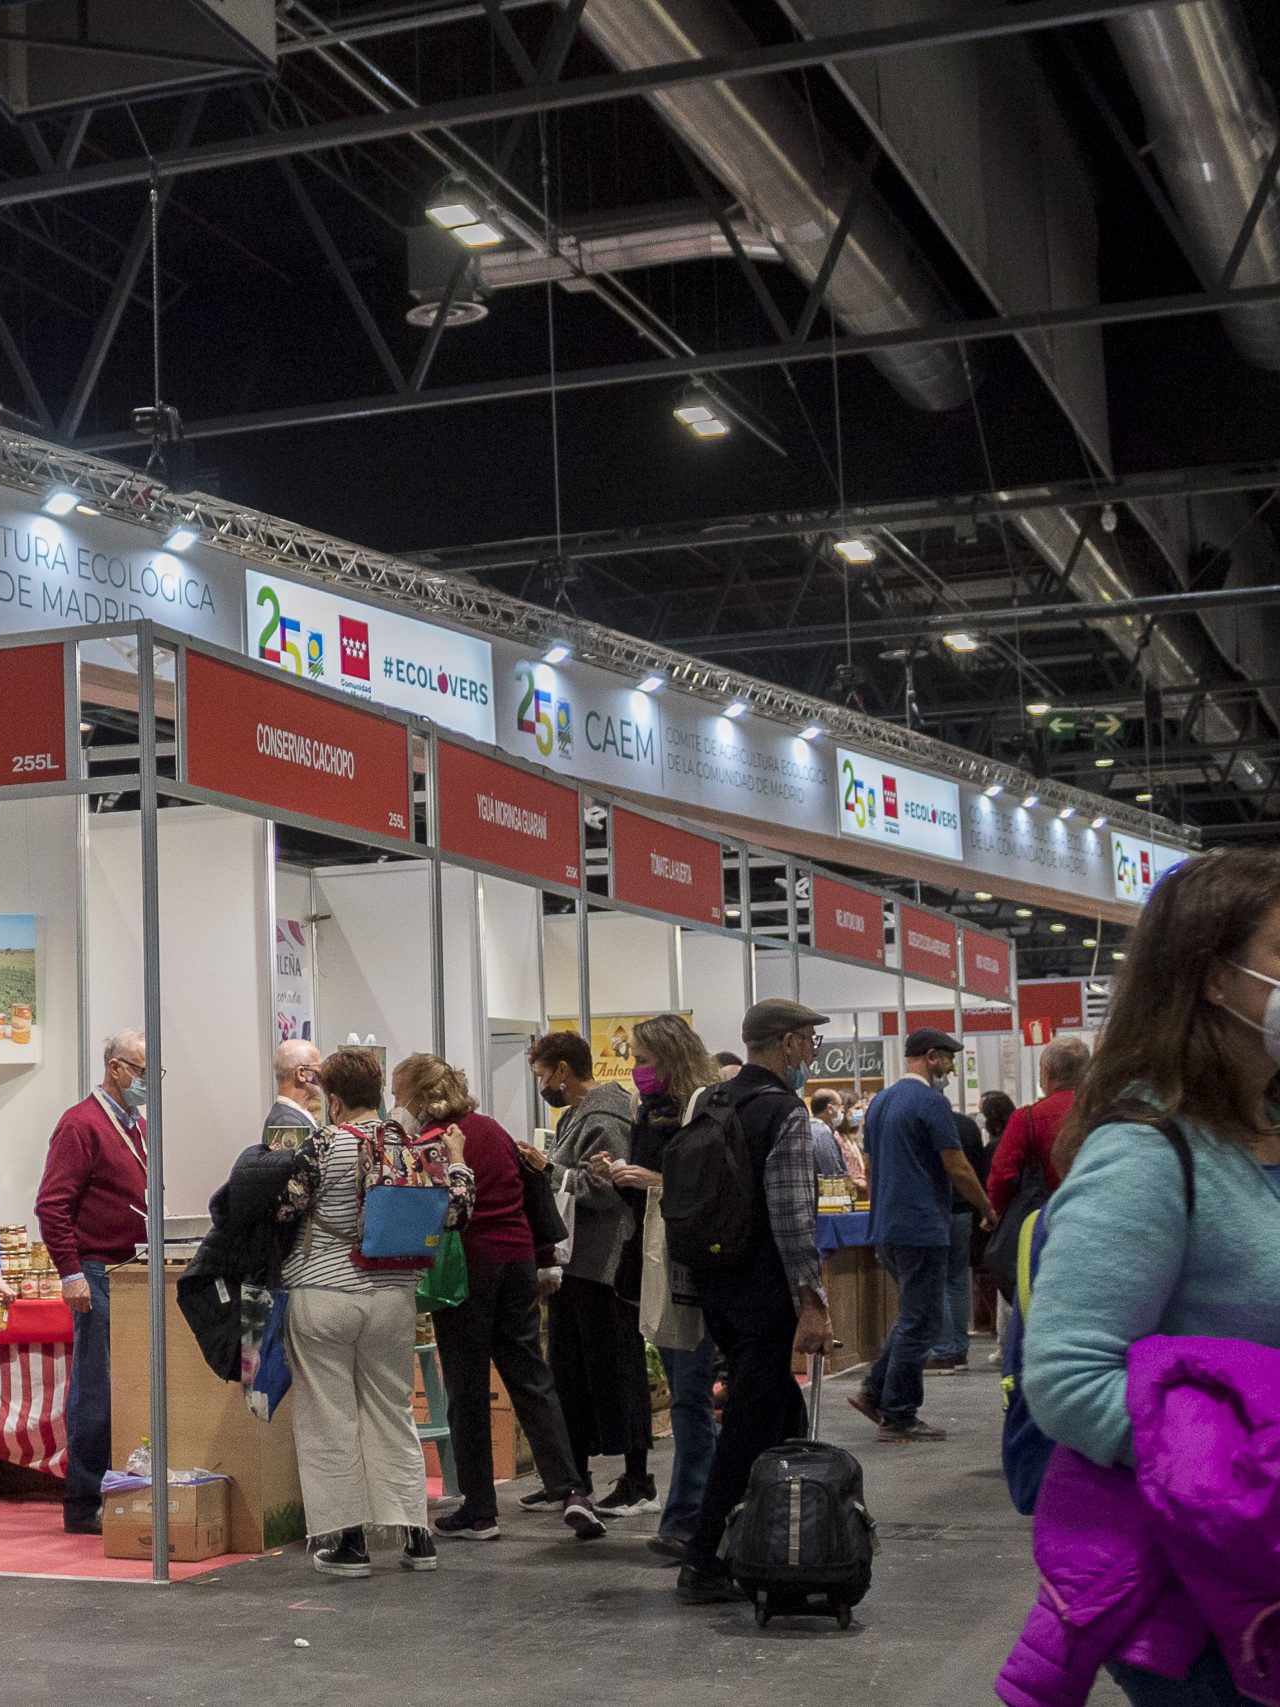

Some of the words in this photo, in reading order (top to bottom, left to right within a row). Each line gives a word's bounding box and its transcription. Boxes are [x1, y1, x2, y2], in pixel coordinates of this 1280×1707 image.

[78, 546, 217, 615] ECOLÓGICA
[513, 660, 553, 757] 25
[12, 753, 59, 772] 255L
[256, 722, 312, 768] CONSERVAS
[313, 740, 355, 780] CACHOPO
[585, 710, 654, 766] CAEM
[667, 753, 681, 772] DE
[683, 759, 695, 776] LA
[388, 812, 406, 830] 255L
[843, 758, 866, 828] 25
